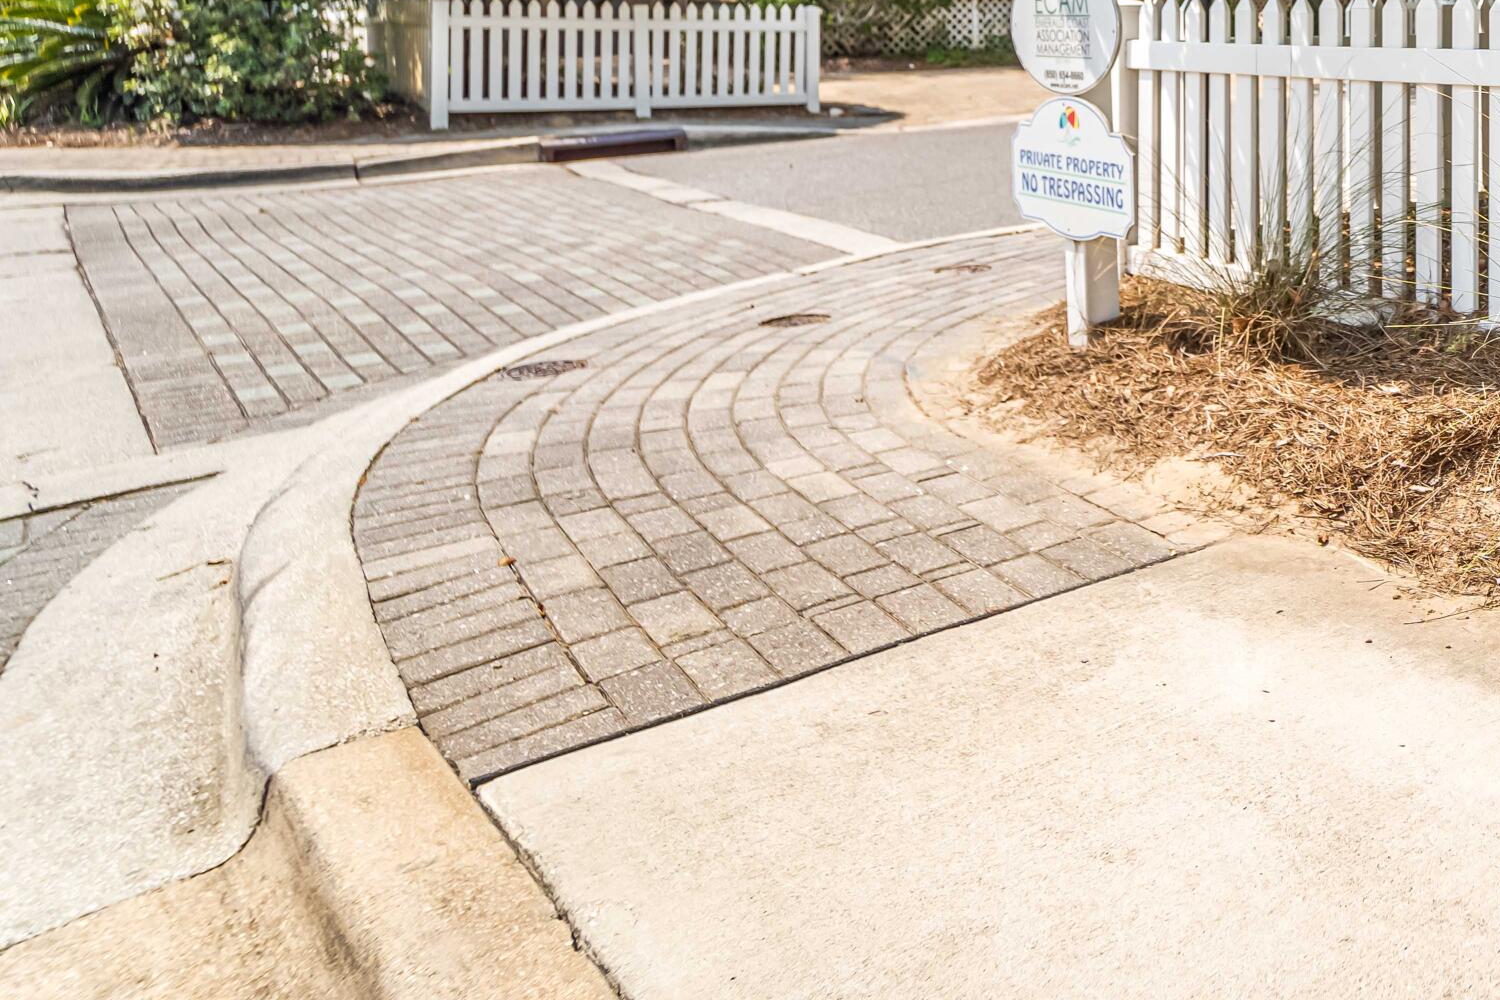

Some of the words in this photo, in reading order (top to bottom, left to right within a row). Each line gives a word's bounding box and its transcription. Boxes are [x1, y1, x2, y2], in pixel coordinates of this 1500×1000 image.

[1036, 29, 1090, 43] ASSOCIATION
[1036, 43, 1090, 56] MANAGEMENT
[1020, 149, 1063, 170] PRIVATE
[1066, 156, 1124, 180] PROPERTY
[1022, 171, 1038, 193] NO
[1041, 175, 1124, 209] TRESPASSING
